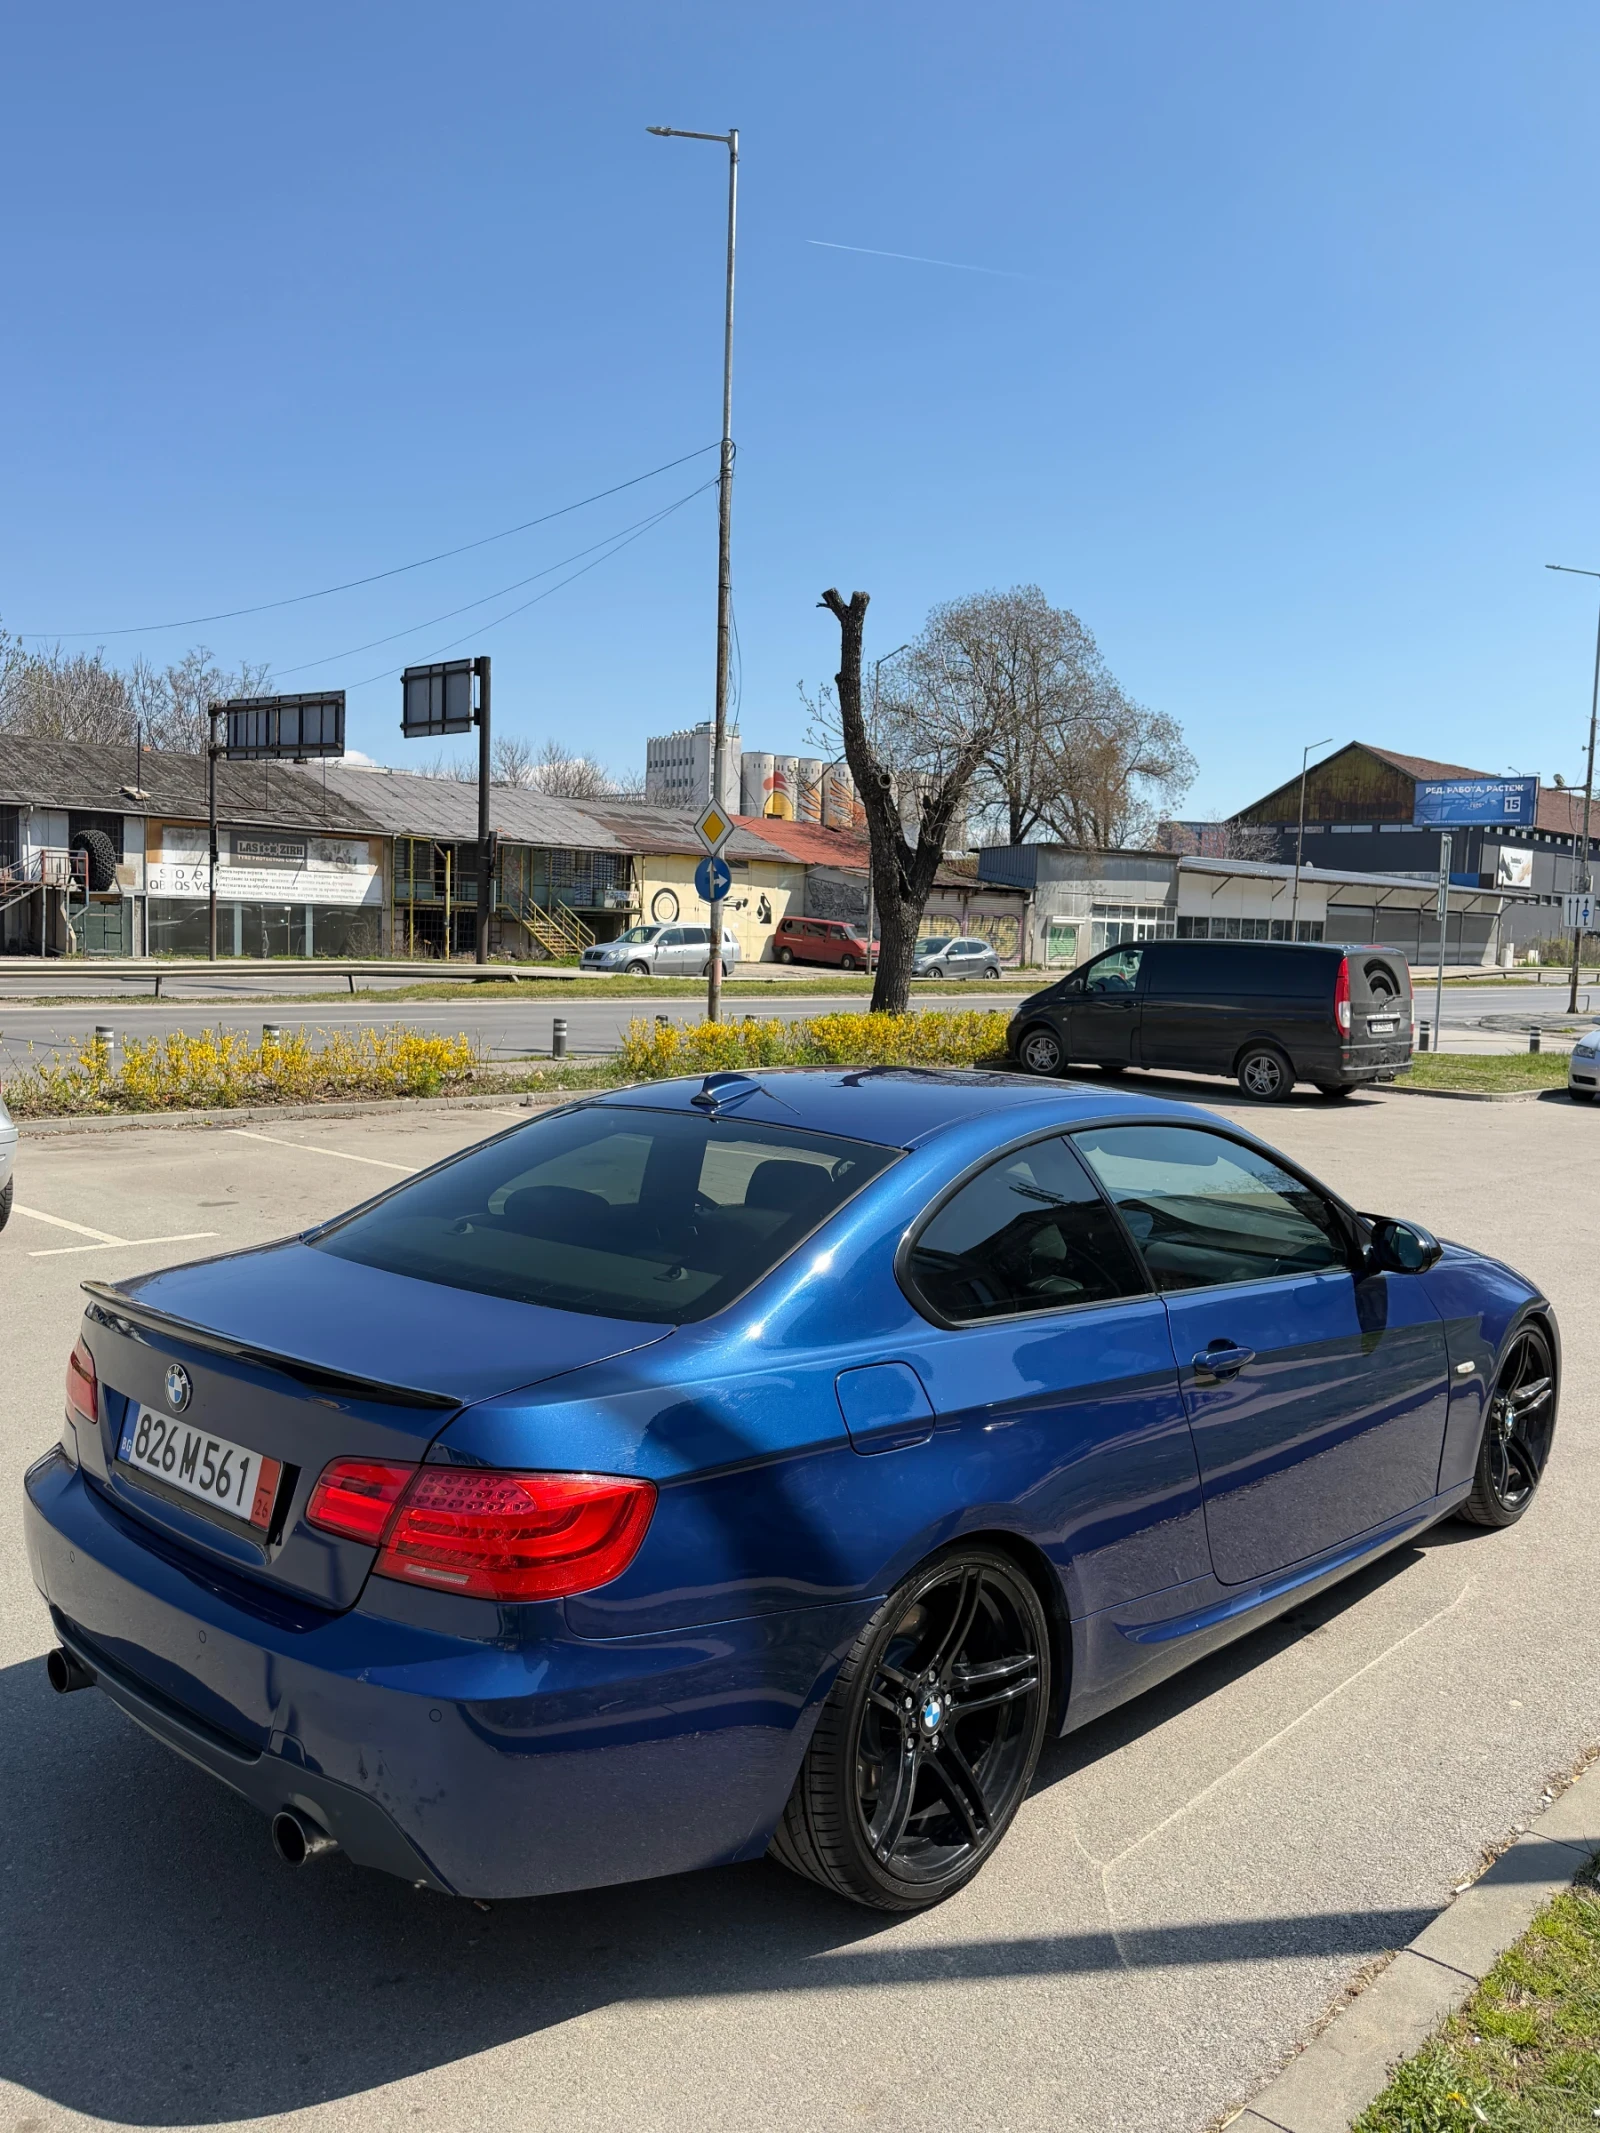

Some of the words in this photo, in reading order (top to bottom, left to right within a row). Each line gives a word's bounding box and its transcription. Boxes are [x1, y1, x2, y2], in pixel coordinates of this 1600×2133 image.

[1486, 784, 1524, 792] РАСТЕЖ
[1506, 799, 1519, 810] 15
[239, 842, 259, 853] LAS
[279, 845, 304, 856] ZIRH
[251, 855, 285, 863] PROTECTION
[121, 1437, 132, 1452] BG
[254, 1498, 269, 1519] 26
